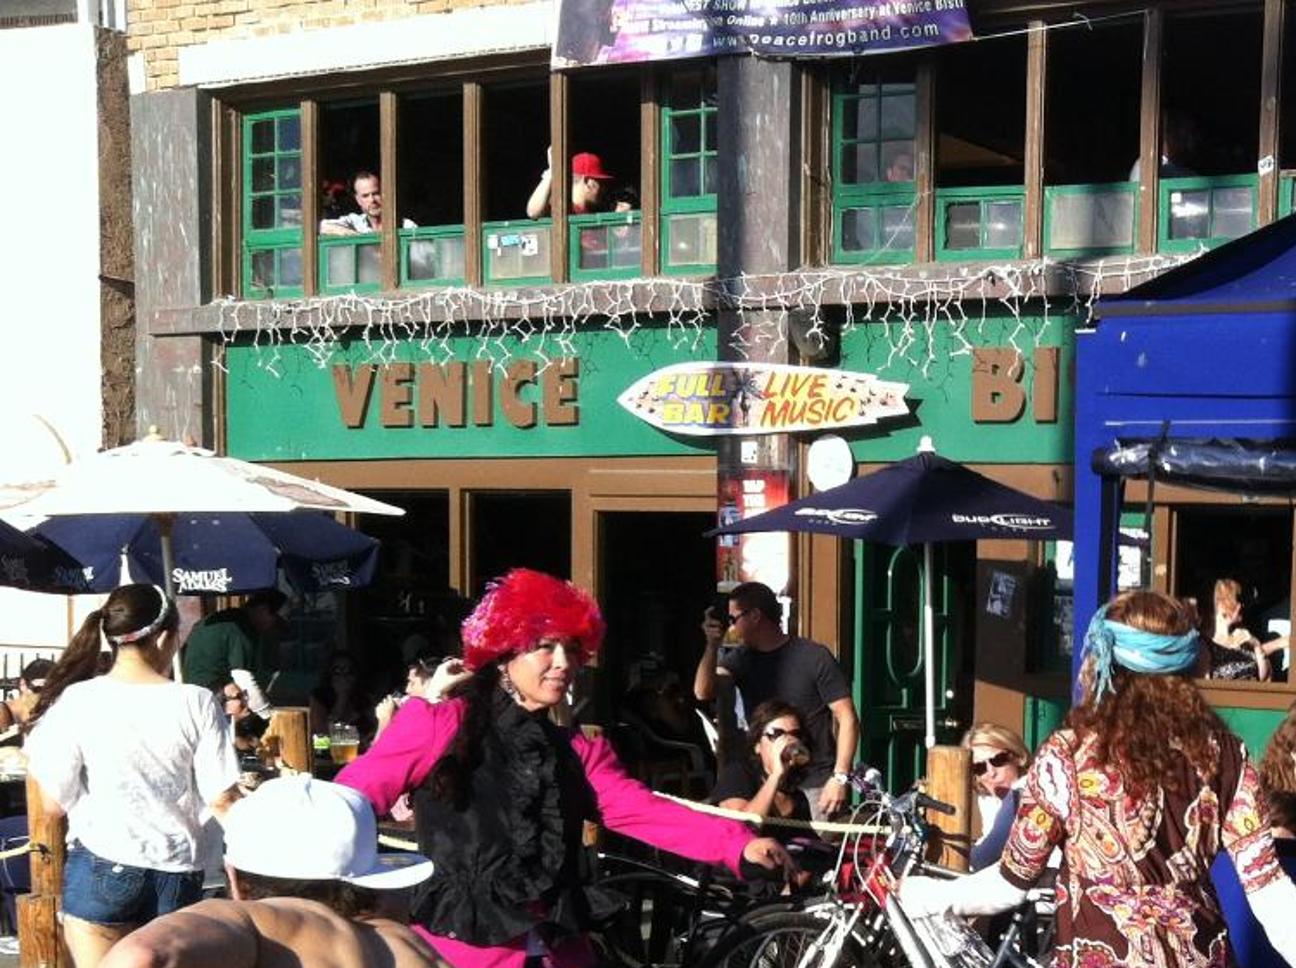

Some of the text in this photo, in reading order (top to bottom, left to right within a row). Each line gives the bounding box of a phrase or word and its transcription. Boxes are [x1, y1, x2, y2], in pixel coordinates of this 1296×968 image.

[784, 11, 808, 25] 10th
[809, 6, 876, 24] Anniversary
[891, 0, 933, 15] Venice
[332, 357, 579, 428] VENICE
[656, 372, 726, 398] FULL
[762, 371, 828, 399] LIVE
[661, 401, 731, 425] BAR
[759, 399, 854, 427] MUSIC
[172, 567, 233, 583] SAMUEL
